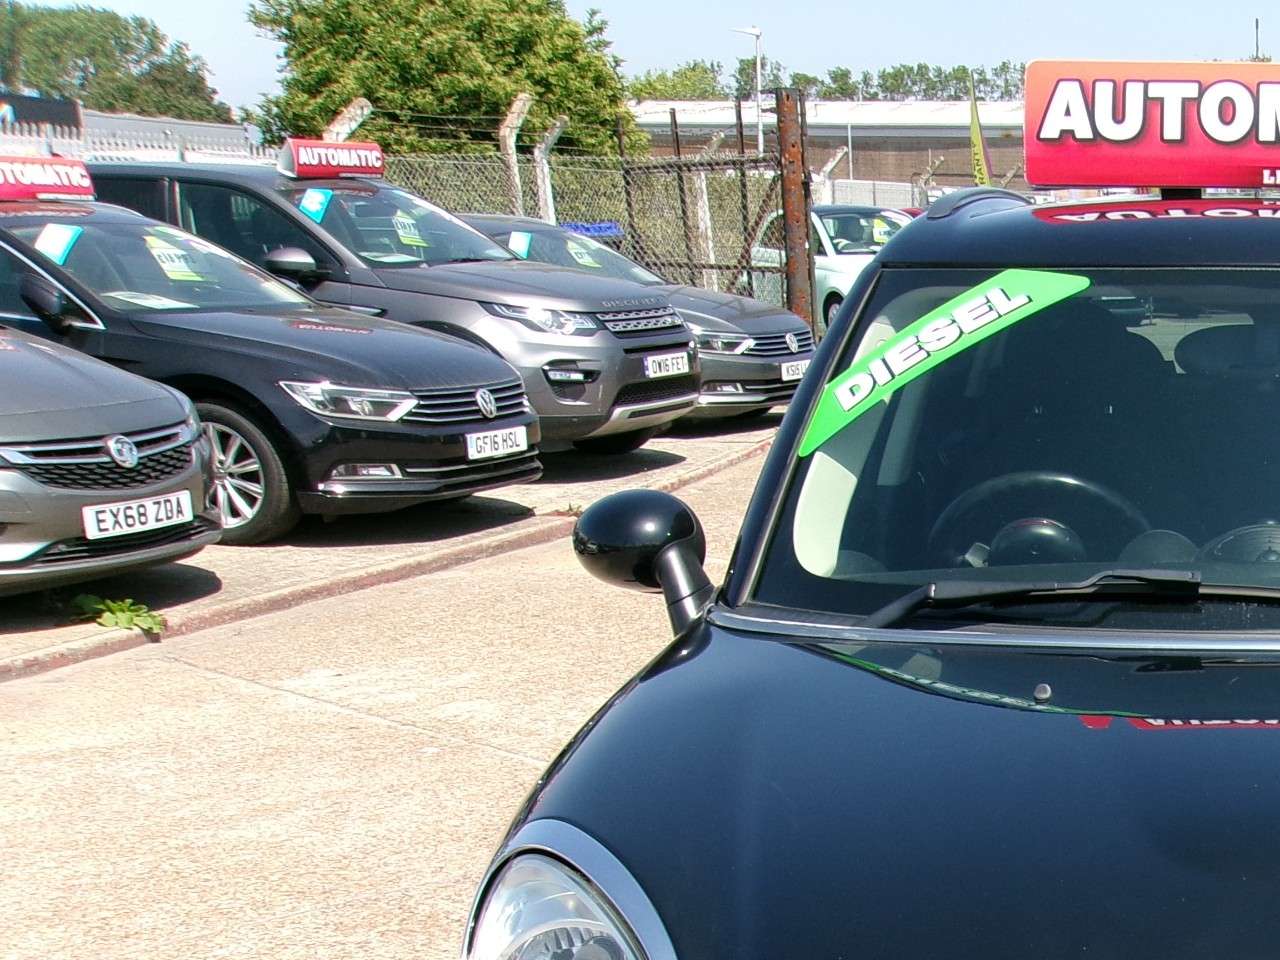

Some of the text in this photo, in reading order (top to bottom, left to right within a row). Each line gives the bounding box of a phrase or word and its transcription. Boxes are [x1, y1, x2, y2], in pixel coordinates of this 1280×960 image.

[297, 145, 382, 168] AUTOMATIC
[0, 161, 91, 188] TOMATIC
[833, 287, 1034, 413] DIESEL
[475, 431, 520, 454] GF16 HSL
[95, 496, 185, 532] EX68 ZDA
